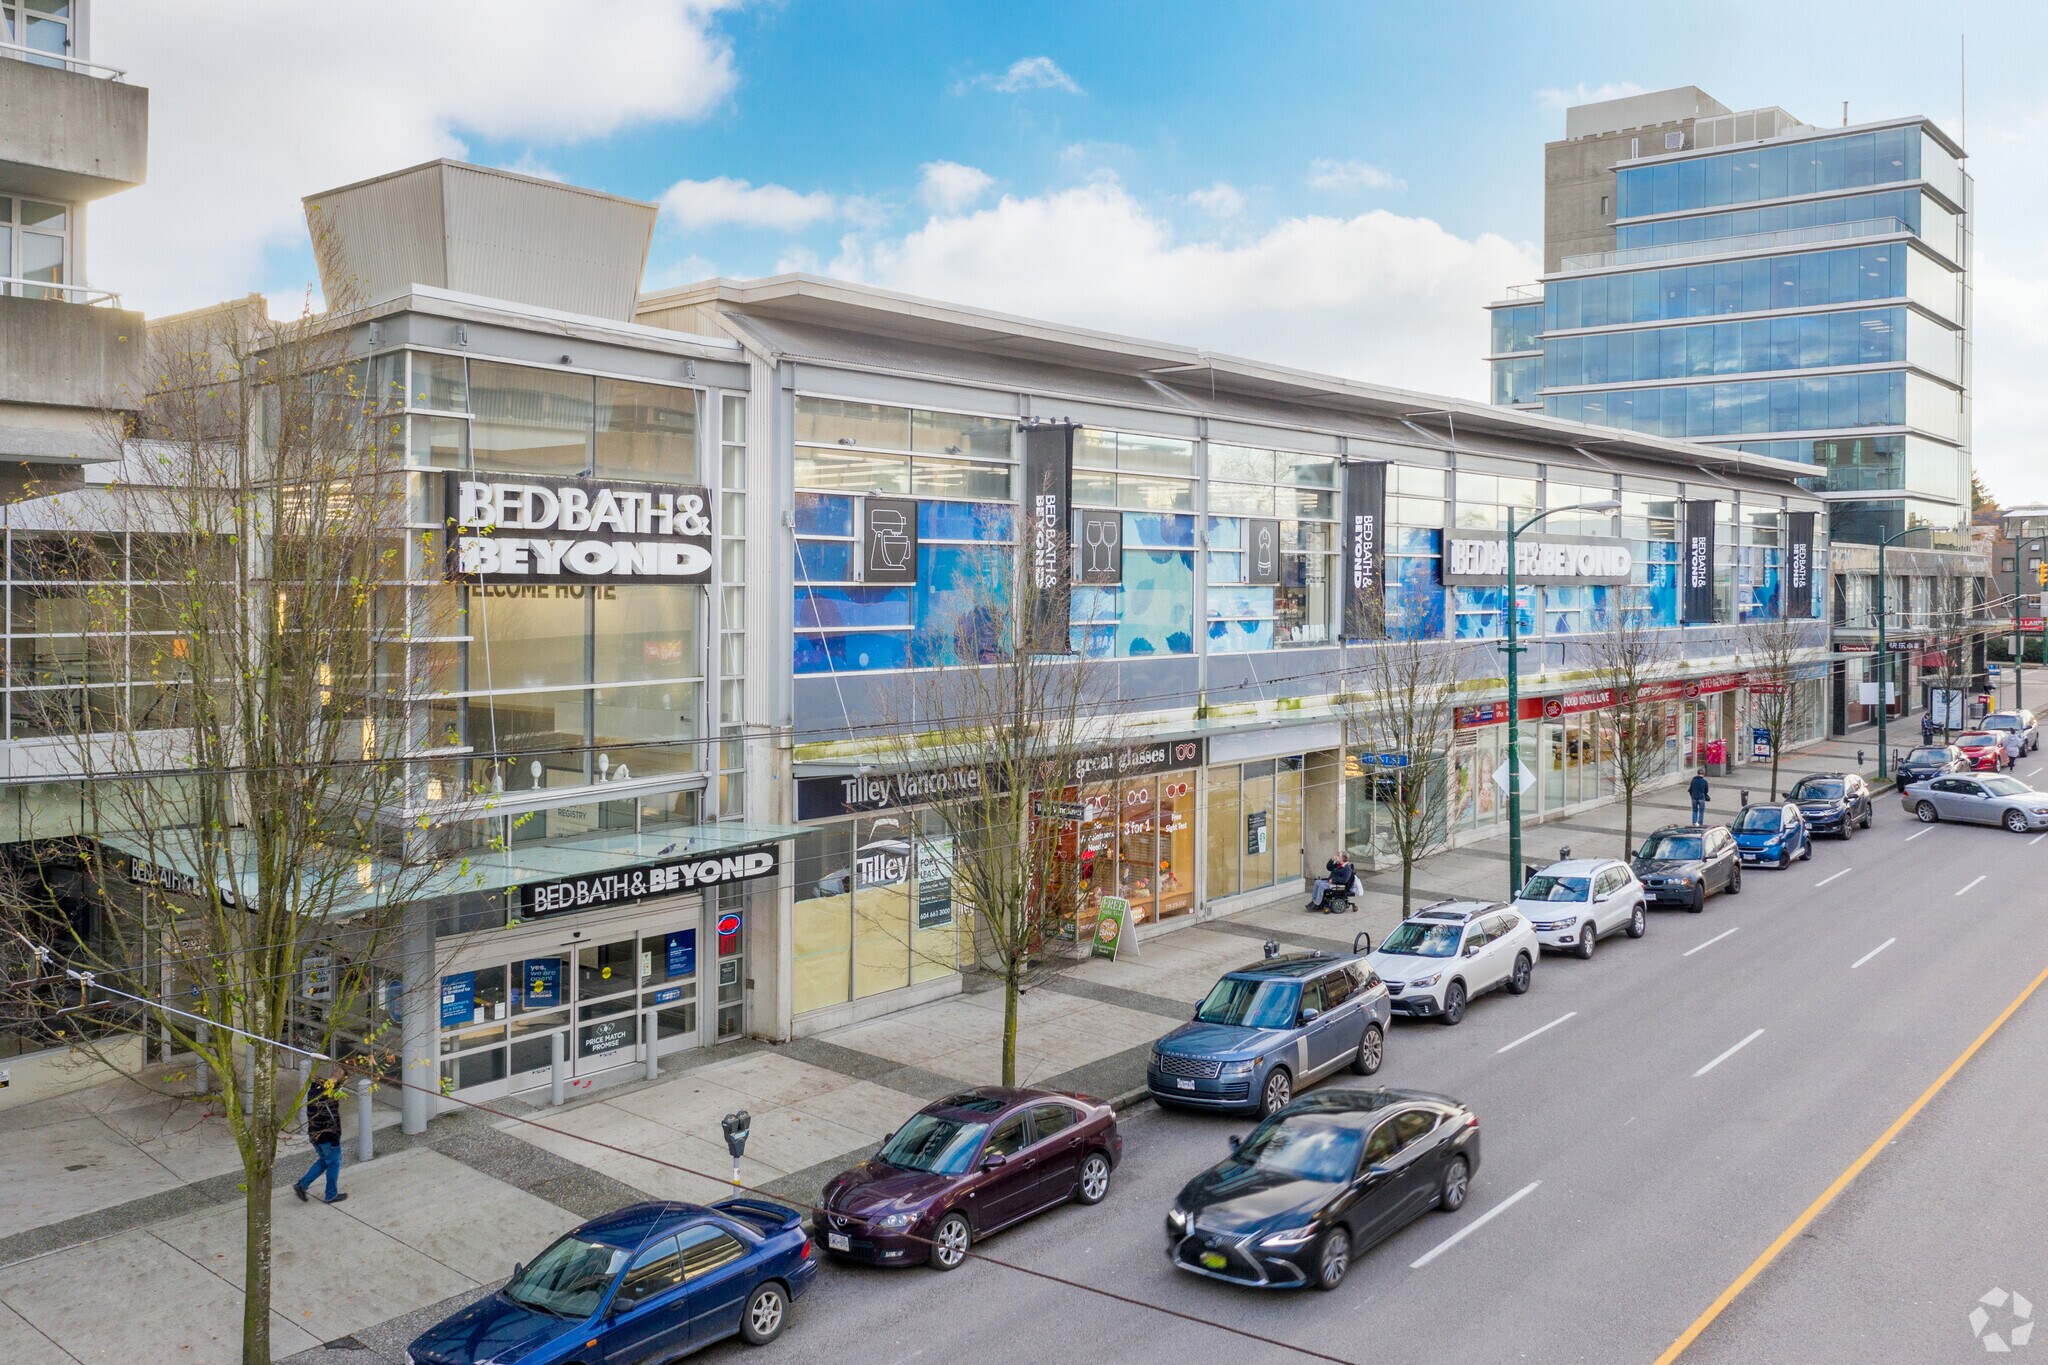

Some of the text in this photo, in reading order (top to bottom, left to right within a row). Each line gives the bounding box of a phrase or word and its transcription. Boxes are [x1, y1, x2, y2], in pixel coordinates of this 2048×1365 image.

[1045, 494, 1057, 588] BED BATH &
[1362, 515, 1373, 588] BED BATH &
[1698, 536, 1706, 555] BED
[459, 537, 713, 576] BEYOND
[1354, 515, 1363, 589] BEYOND
[1538, 543, 1632, 577] BEYOND
[1698, 555, 1706, 579] BATH
[555, 586, 617, 600] HOE
[1563, 696, 1579, 708] FOOD
[1118, 747, 1165, 773] glasses
[841, 776, 891, 807] Tilley
[557, 808, 587, 821] REGISTRY
[1124, 819, 1151, 836] 3 for 1
[856, 853, 910, 886] Tilley
[920, 858, 934, 868] FOR
[534, 852, 774, 912] BED BATH & BEYOND
[1102, 898, 1125, 911] FREE
[530, 964, 547, 972] yes,
[585, 1031, 626, 1047] PRICE MATCH
[592, 1039, 620, 1051] PROMISE
